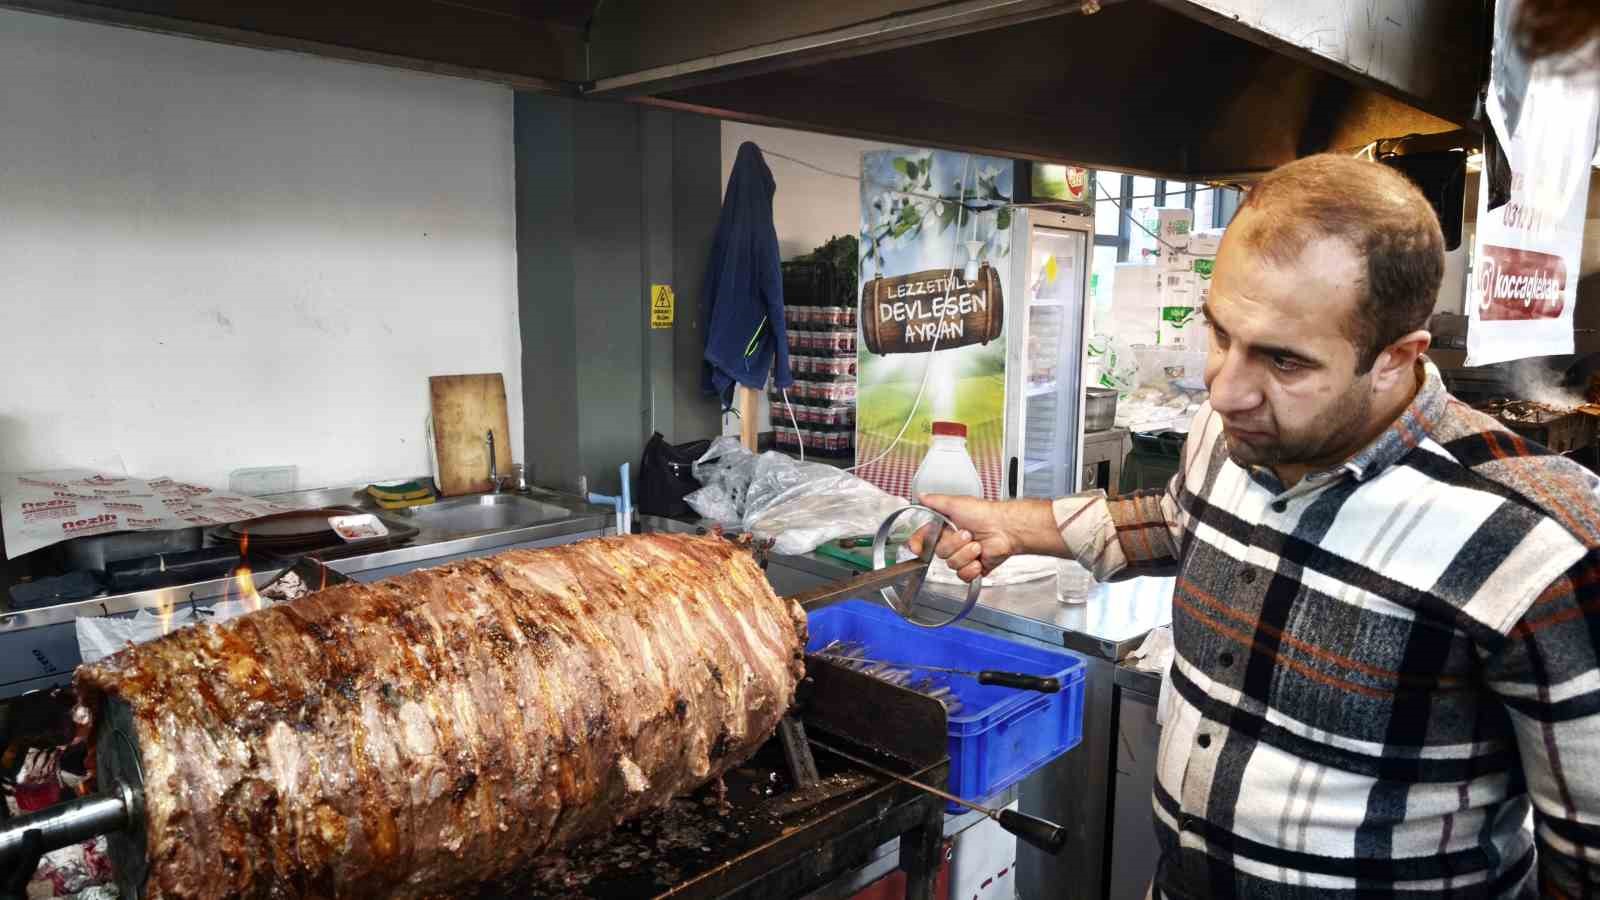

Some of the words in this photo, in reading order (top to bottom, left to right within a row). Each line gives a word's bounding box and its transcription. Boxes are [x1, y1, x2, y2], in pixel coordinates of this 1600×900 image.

[880, 288, 987, 323] DEVLEŞEN
[904, 320, 964, 344] AYRAN
[62, 514, 117, 529] nezih
